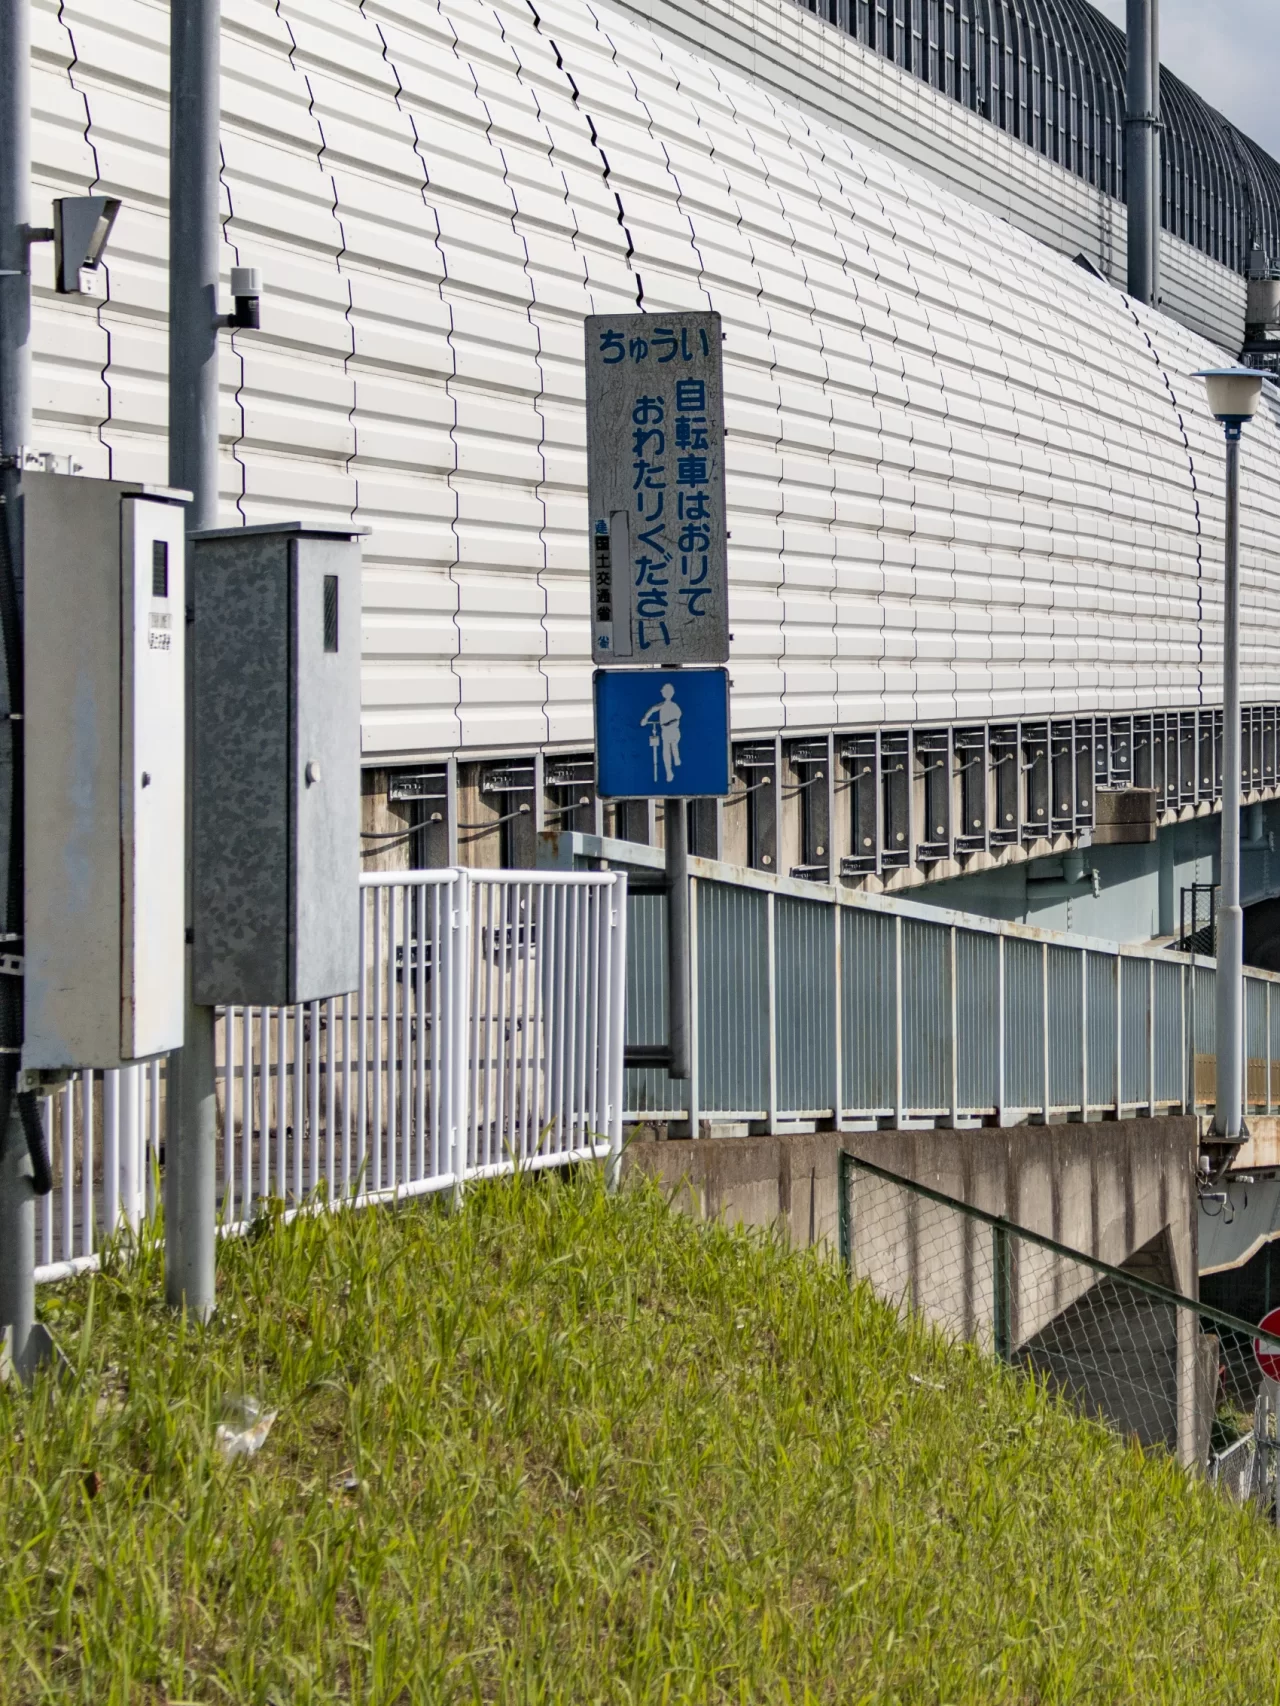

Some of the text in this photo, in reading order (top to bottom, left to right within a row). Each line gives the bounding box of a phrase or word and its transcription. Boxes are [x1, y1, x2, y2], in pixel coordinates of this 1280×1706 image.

[599, 328, 710, 366] ちゅうい
[631, 394, 673, 651] おわたりください
[675, 376, 713, 618] 自転車はおりて
